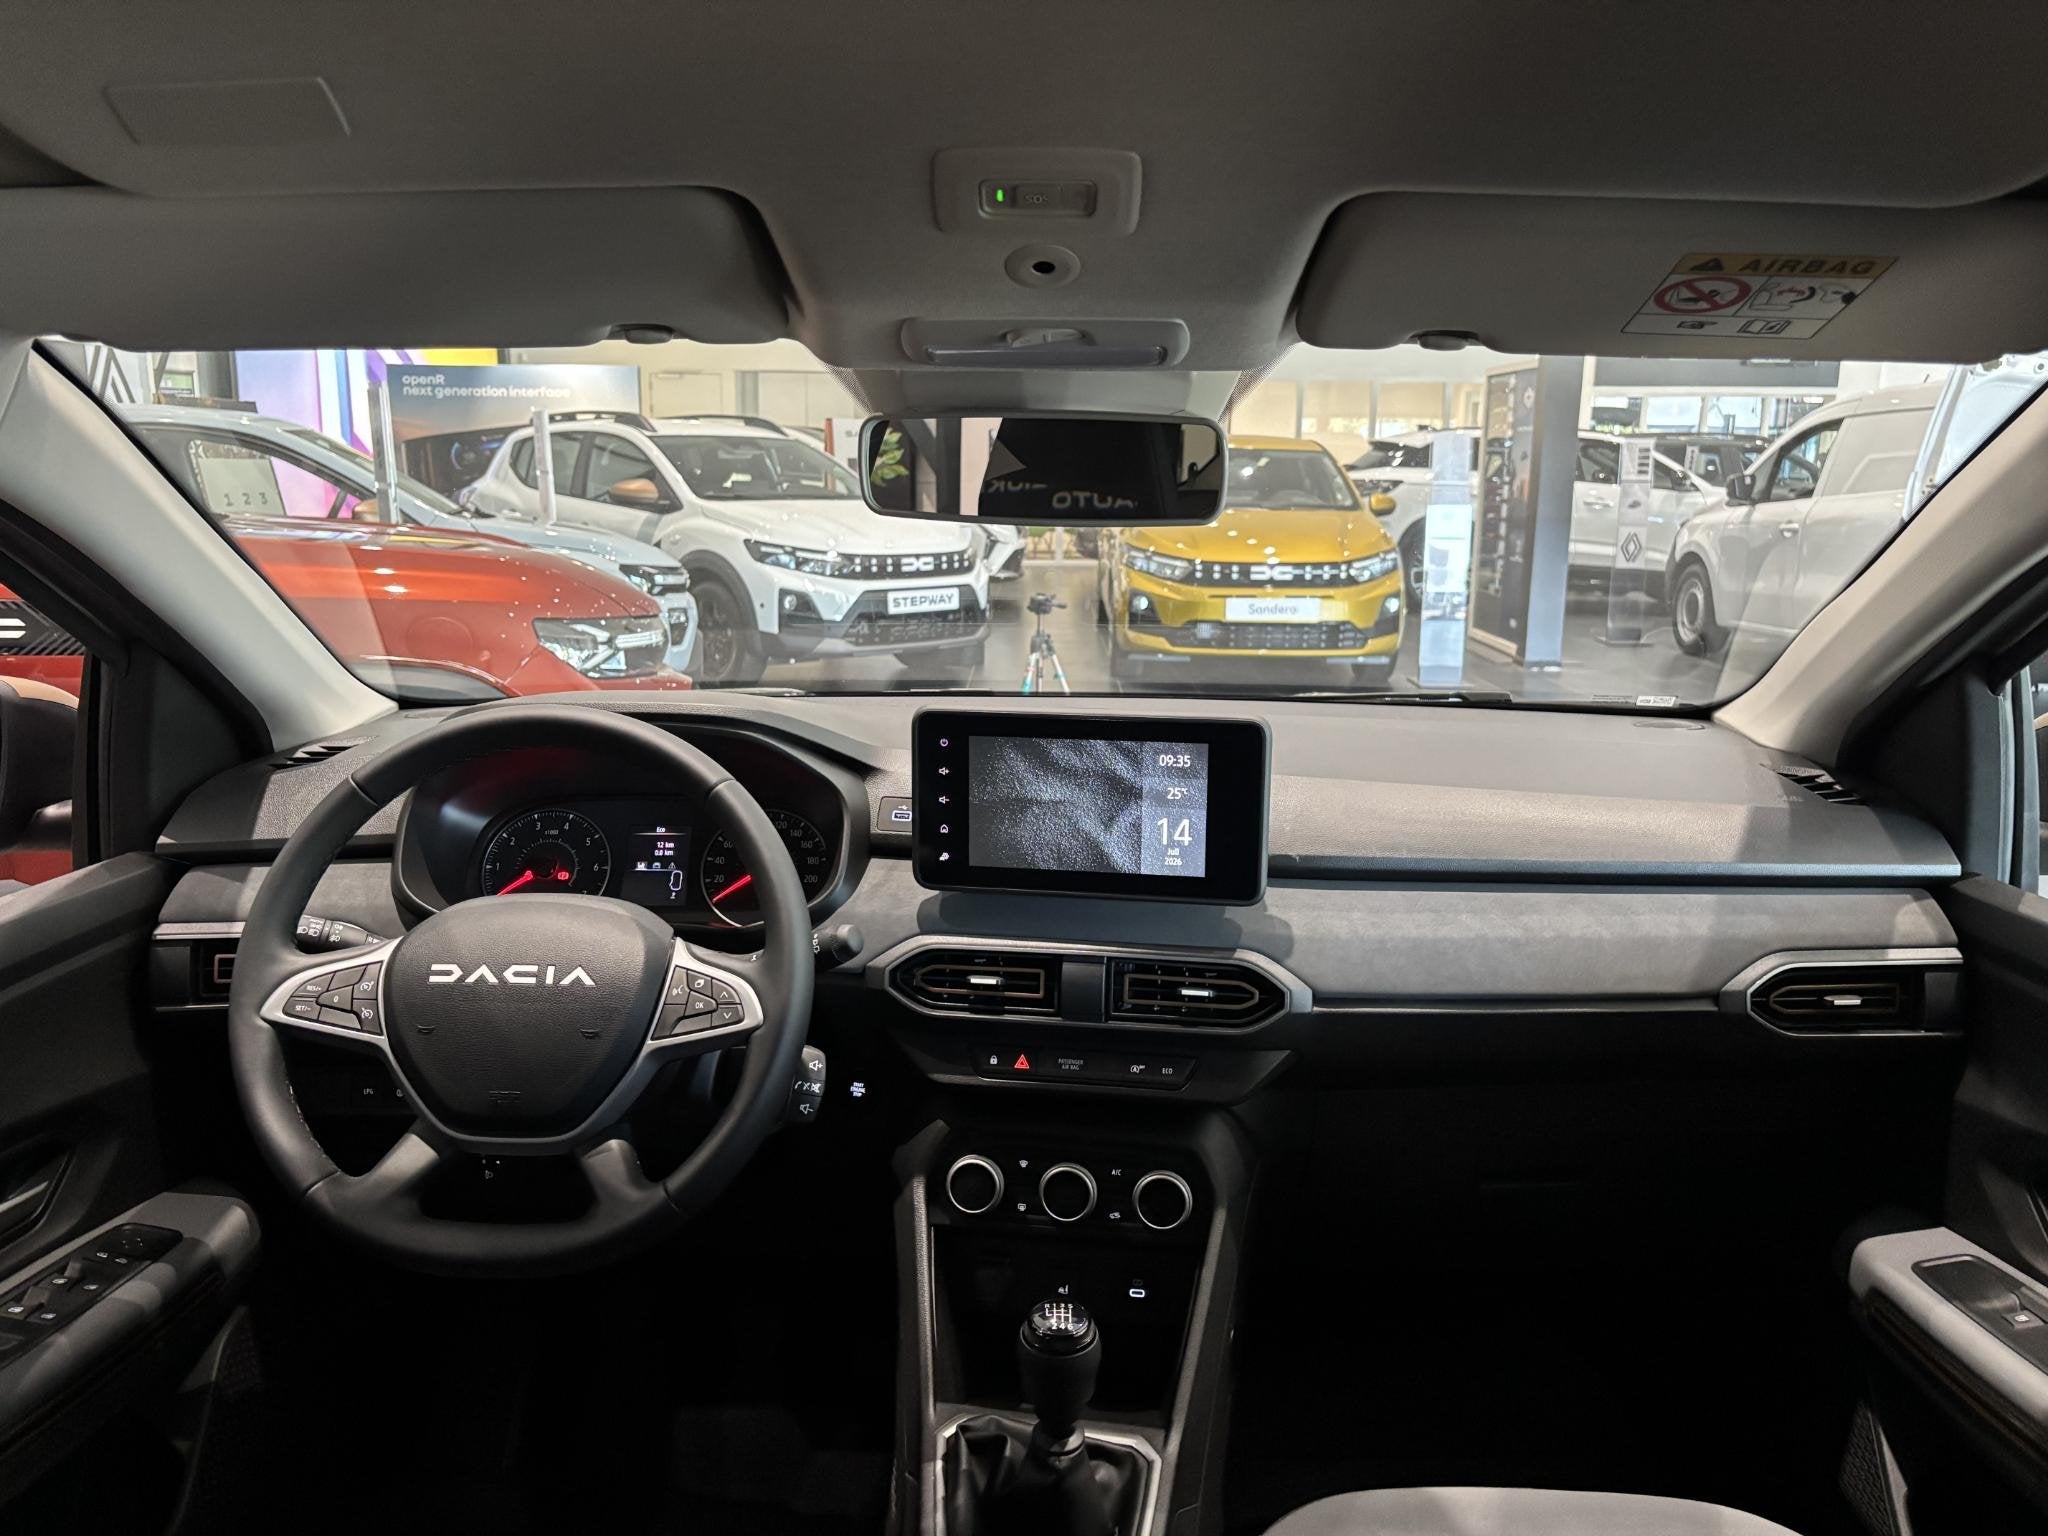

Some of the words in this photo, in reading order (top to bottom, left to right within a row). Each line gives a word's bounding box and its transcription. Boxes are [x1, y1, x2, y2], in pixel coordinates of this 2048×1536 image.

[1738, 258, 1877, 275] AIRBAG
[402, 374, 445, 386] openR
[403, 386, 433, 397] next
[434, 385, 508, 398] generation
[508, 385, 572, 398] interface
[224, 493, 234, 507] 1
[242, 492, 251, 505] 2
[258, 492, 268, 505] 3
[892, 593, 955, 609] STEPWAY
[1248, 603, 1298, 615] Sandero
[1159, 754, 1191, 768] 09:35
[535, 822, 541, 831] 3
[564, 822, 570, 830] 4
[790, 829, 802, 837] 140
[1157, 817, 1193, 847] 14
[509, 838, 516, 846] 2
[585, 837, 591, 846] 5
[800, 840, 813, 849] 160
[715, 856, 725, 865] 40
[807, 857, 820, 865] 180
[1164, 857, 1183, 866] 2026
[593, 863, 599, 872] 6
[714, 875, 725, 883] 20
[804, 875, 818, 883] 200
[428, 963, 596, 986] DACIA
[695, 1001, 704, 1010] OK
[1111, 1168, 1122, 1176] A/C
[1059, 1322, 1066, 1330] 4
